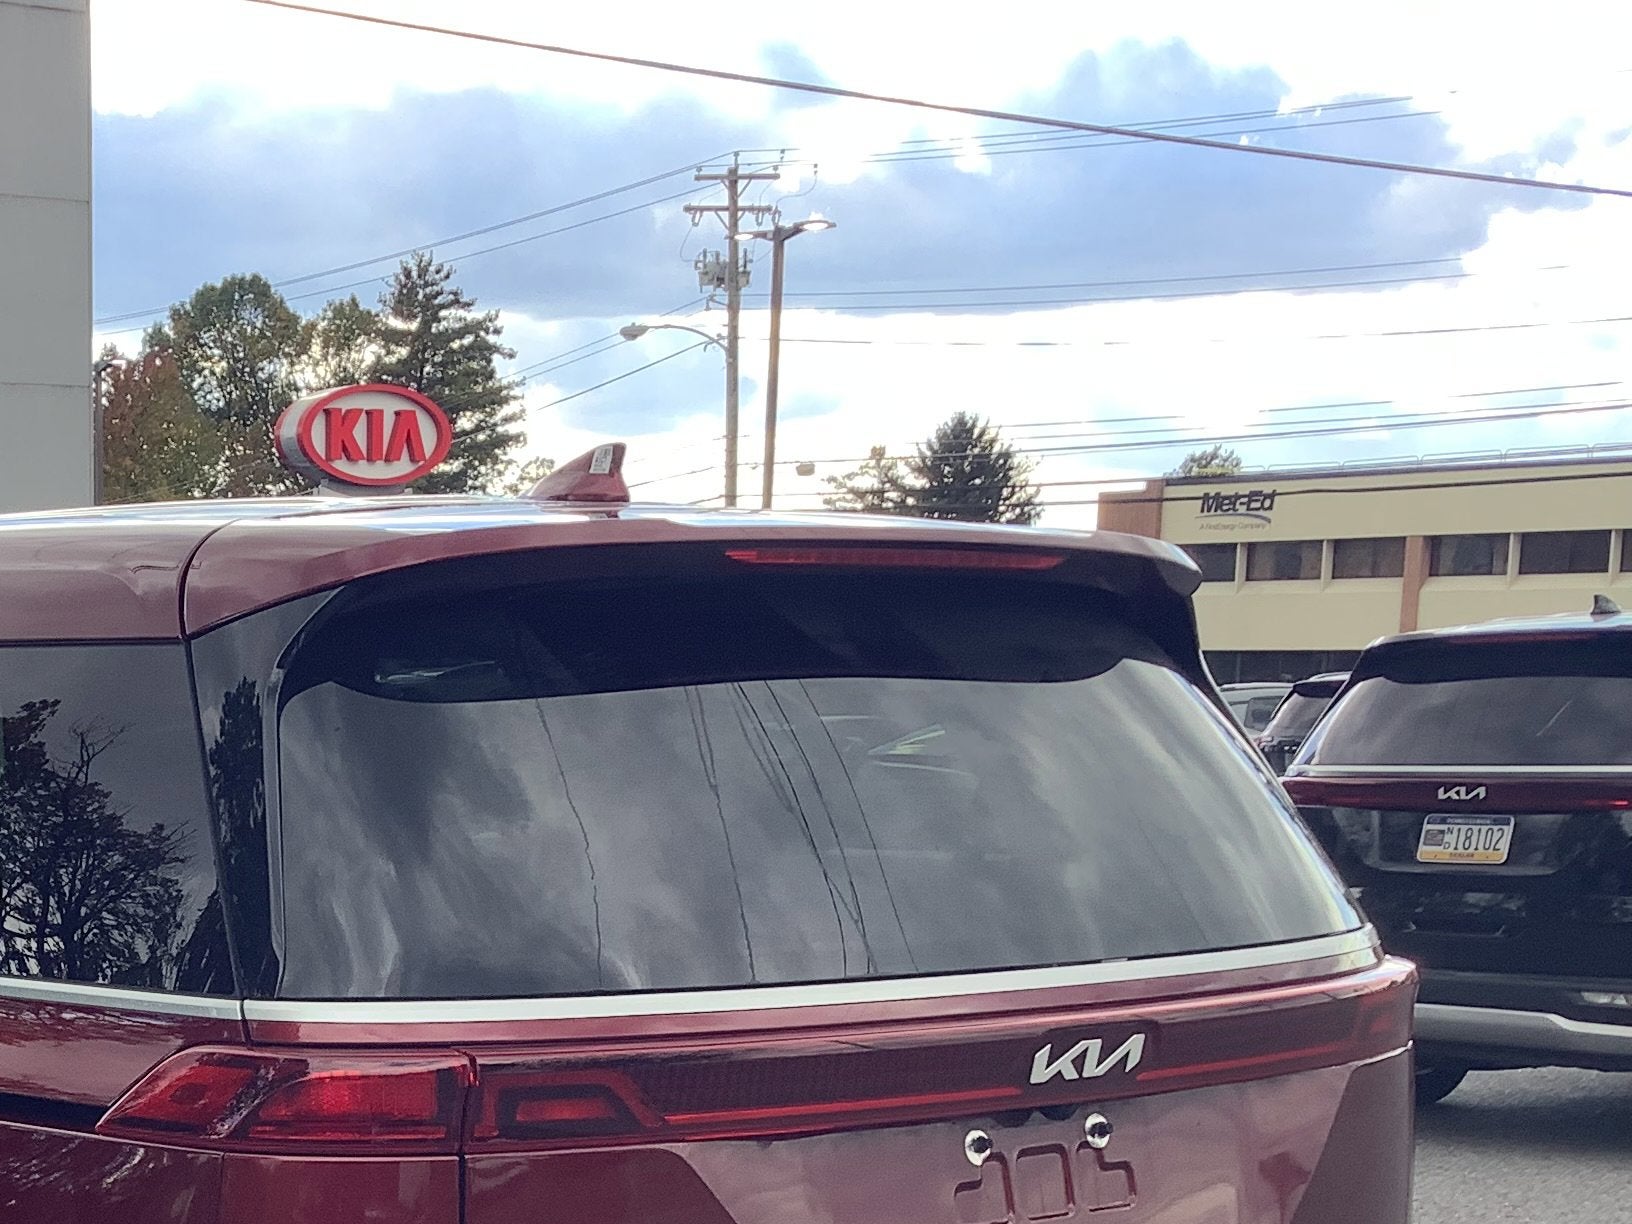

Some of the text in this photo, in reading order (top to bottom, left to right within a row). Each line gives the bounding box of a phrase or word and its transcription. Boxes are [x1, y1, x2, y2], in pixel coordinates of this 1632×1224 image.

[323, 407, 426, 463] KIA
[1200, 489, 1277, 513] Met-Ed
[1437, 786, 1487, 800] KIA
[1453, 827, 1505, 851] 18102
[1029, 1033, 1146, 1084] KIA
